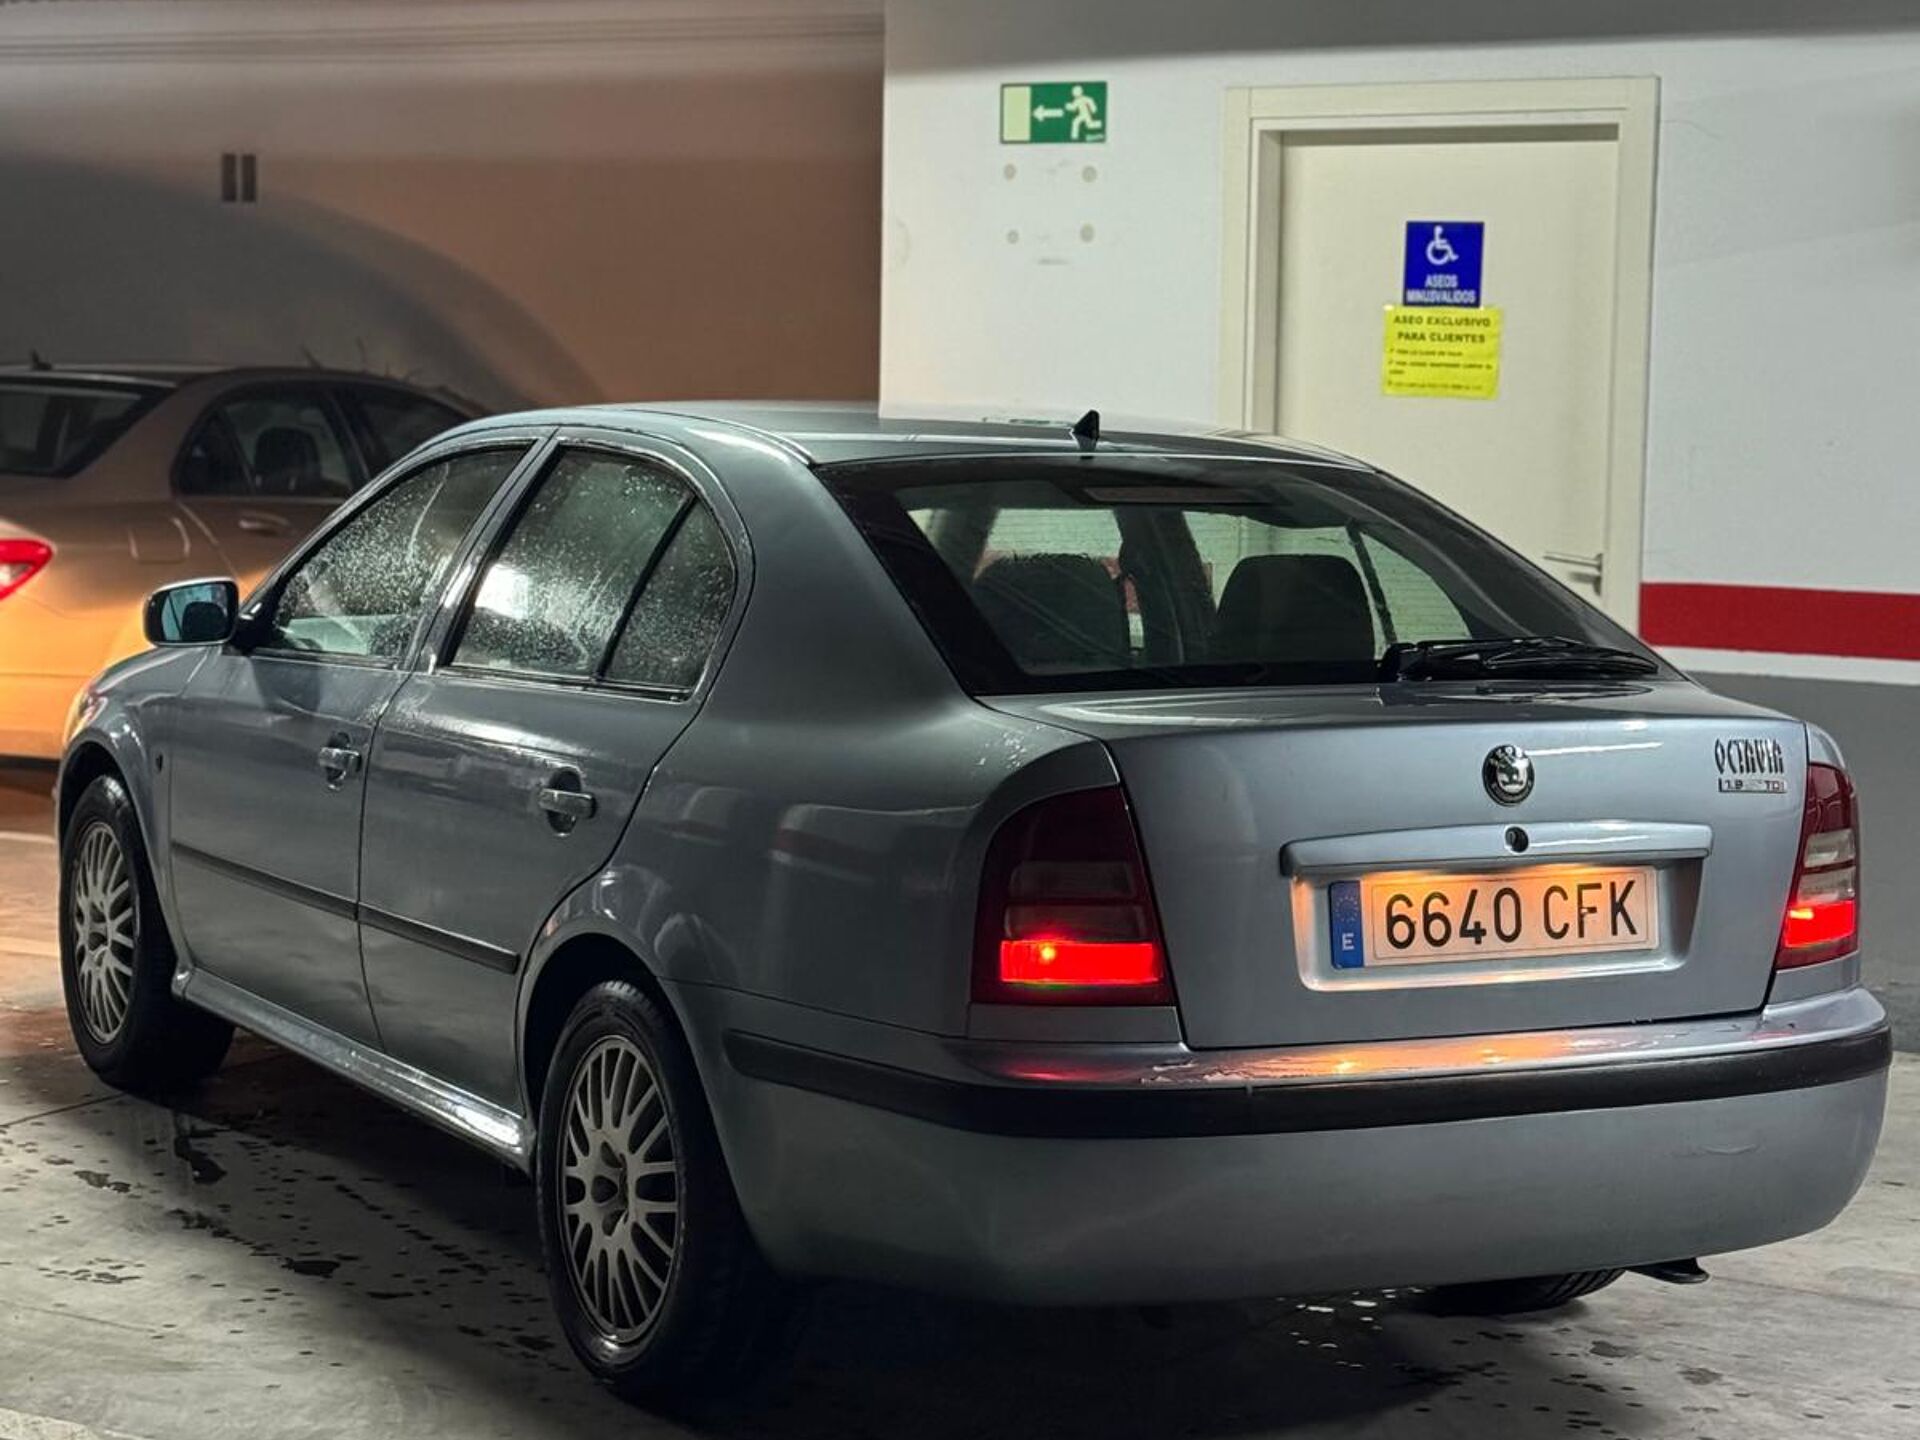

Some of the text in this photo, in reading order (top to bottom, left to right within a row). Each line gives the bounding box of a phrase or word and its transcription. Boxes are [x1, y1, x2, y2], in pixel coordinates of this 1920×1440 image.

[1424, 274, 1458, 288] ASEOS
[1394, 315, 1491, 327] ASEO EXCLUSIVO
[1397, 331, 1485, 343] PARA CLIENTES
[1715, 738, 1784, 774] OCTAVIA
[1385, 879, 1638, 950] 6640 CFK
[1341, 932, 1355, 951] E
